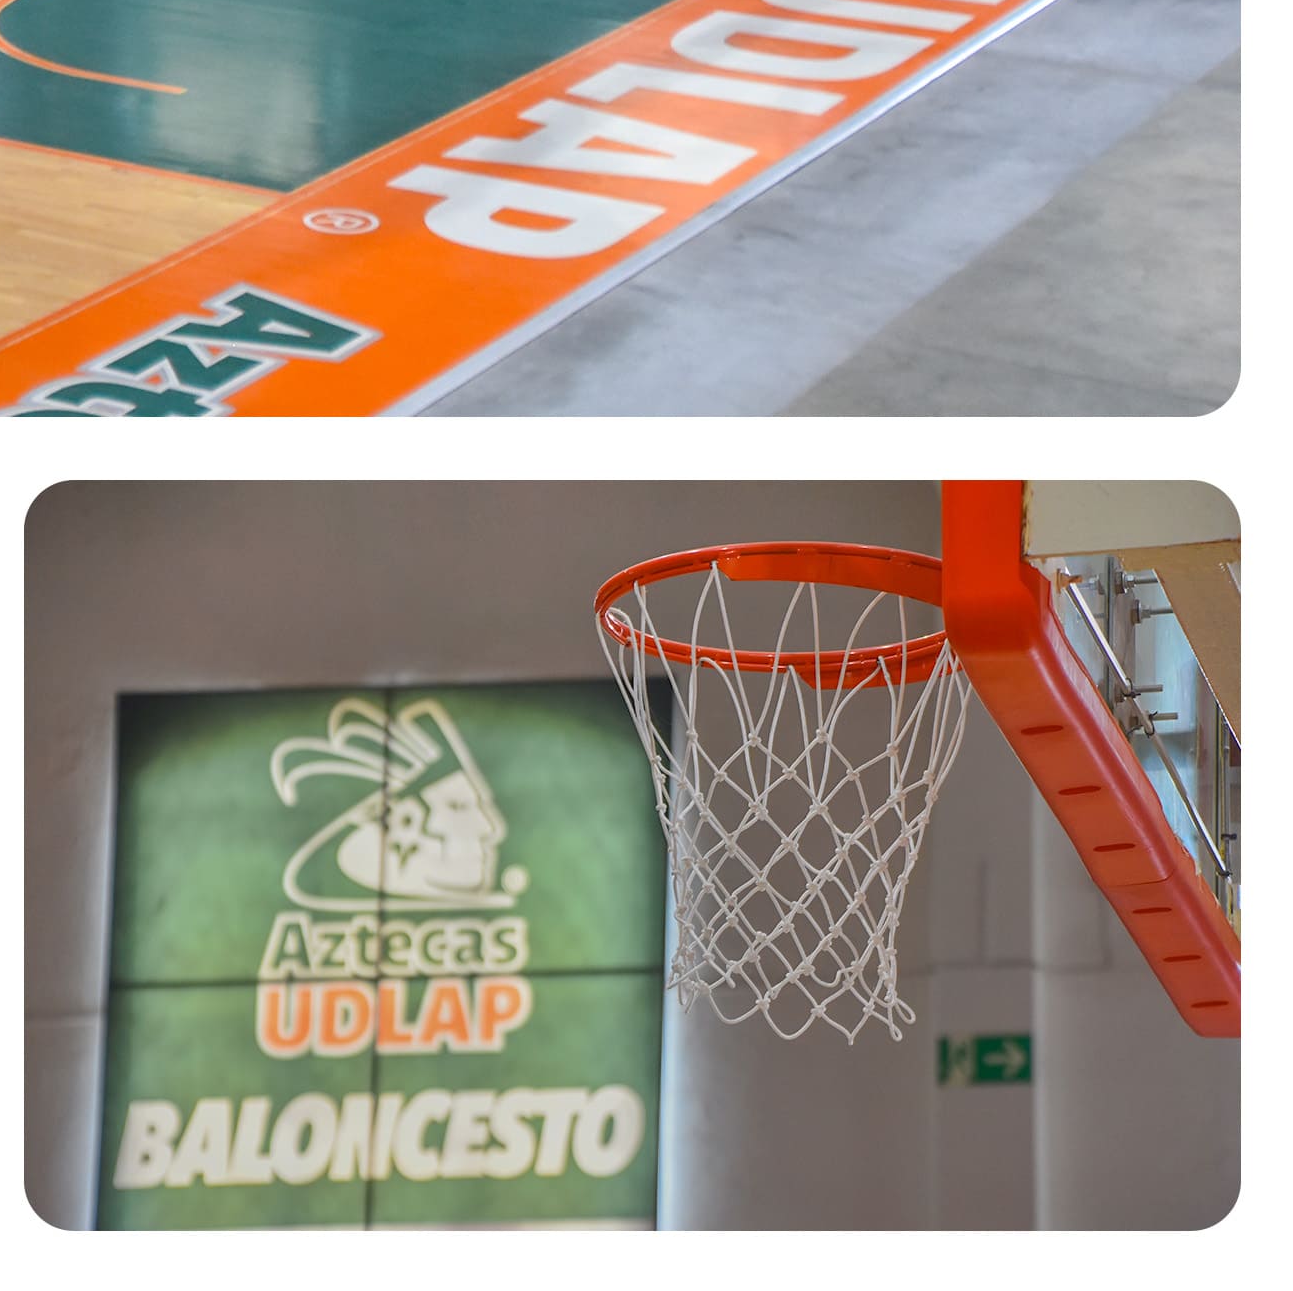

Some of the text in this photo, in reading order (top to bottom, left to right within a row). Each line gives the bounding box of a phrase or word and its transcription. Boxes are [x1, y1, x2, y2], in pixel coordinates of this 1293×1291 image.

[265, 914, 527, 977] Aztecas
[258, 975, 529, 1056] UDLAP
[114, 1084, 645, 1190] BALONCESTO
